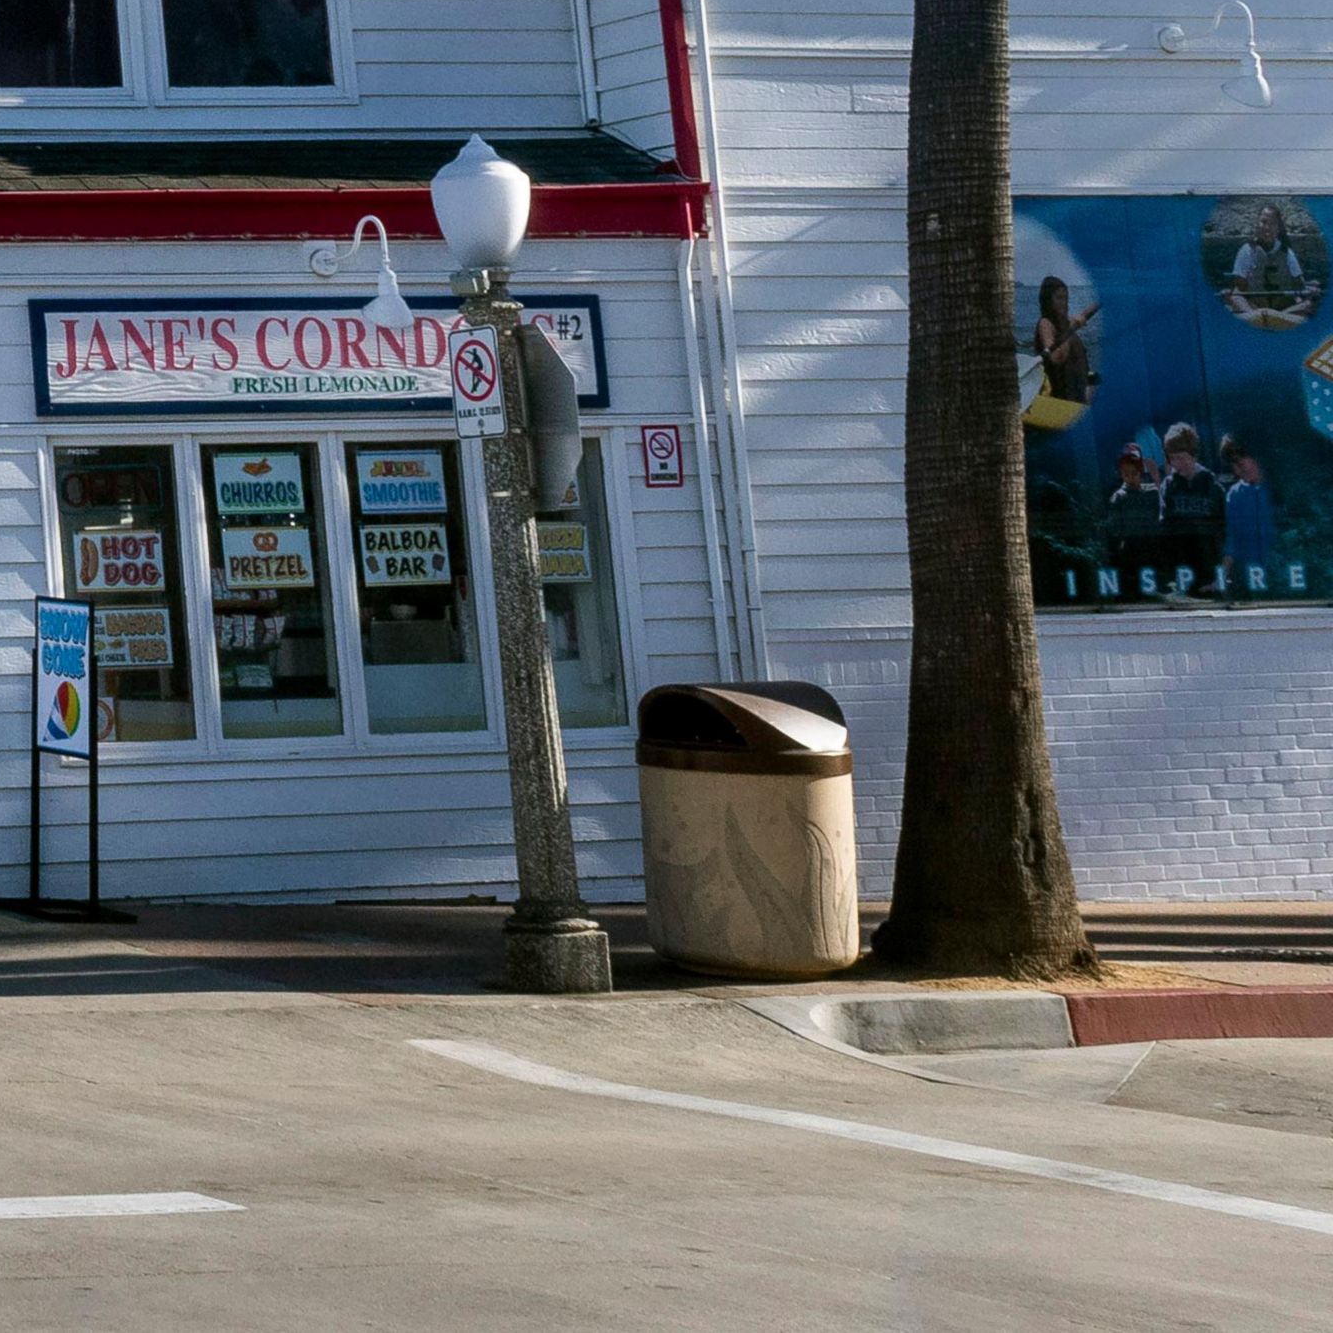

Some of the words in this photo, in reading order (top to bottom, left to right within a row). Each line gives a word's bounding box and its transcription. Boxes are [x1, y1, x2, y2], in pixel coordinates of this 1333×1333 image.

[56, 316, 240, 378] JANE'S
[557, 313, 583, 342] #2
[232, 376, 299, 395] FRESH
[303, 374, 420, 394] LEMONADE
[659, 462, 668, 470] NO
[220, 480, 299, 506] CHURROS
[363, 481, 440, 505] SMOOTHIE
[101, 536, 159, 561] HOT
[365, 530, 443, 551] BALBOA
[104, 562, 162, 587] DOG
[229, 553, 309, 580] PRETZEL
[386, 555, 427, 577] BAR
[1065, 564, 1307, 597] INSPIRE
[40, 607, 89, 646] SNOW
[42, 643, 86, 680] CONE
